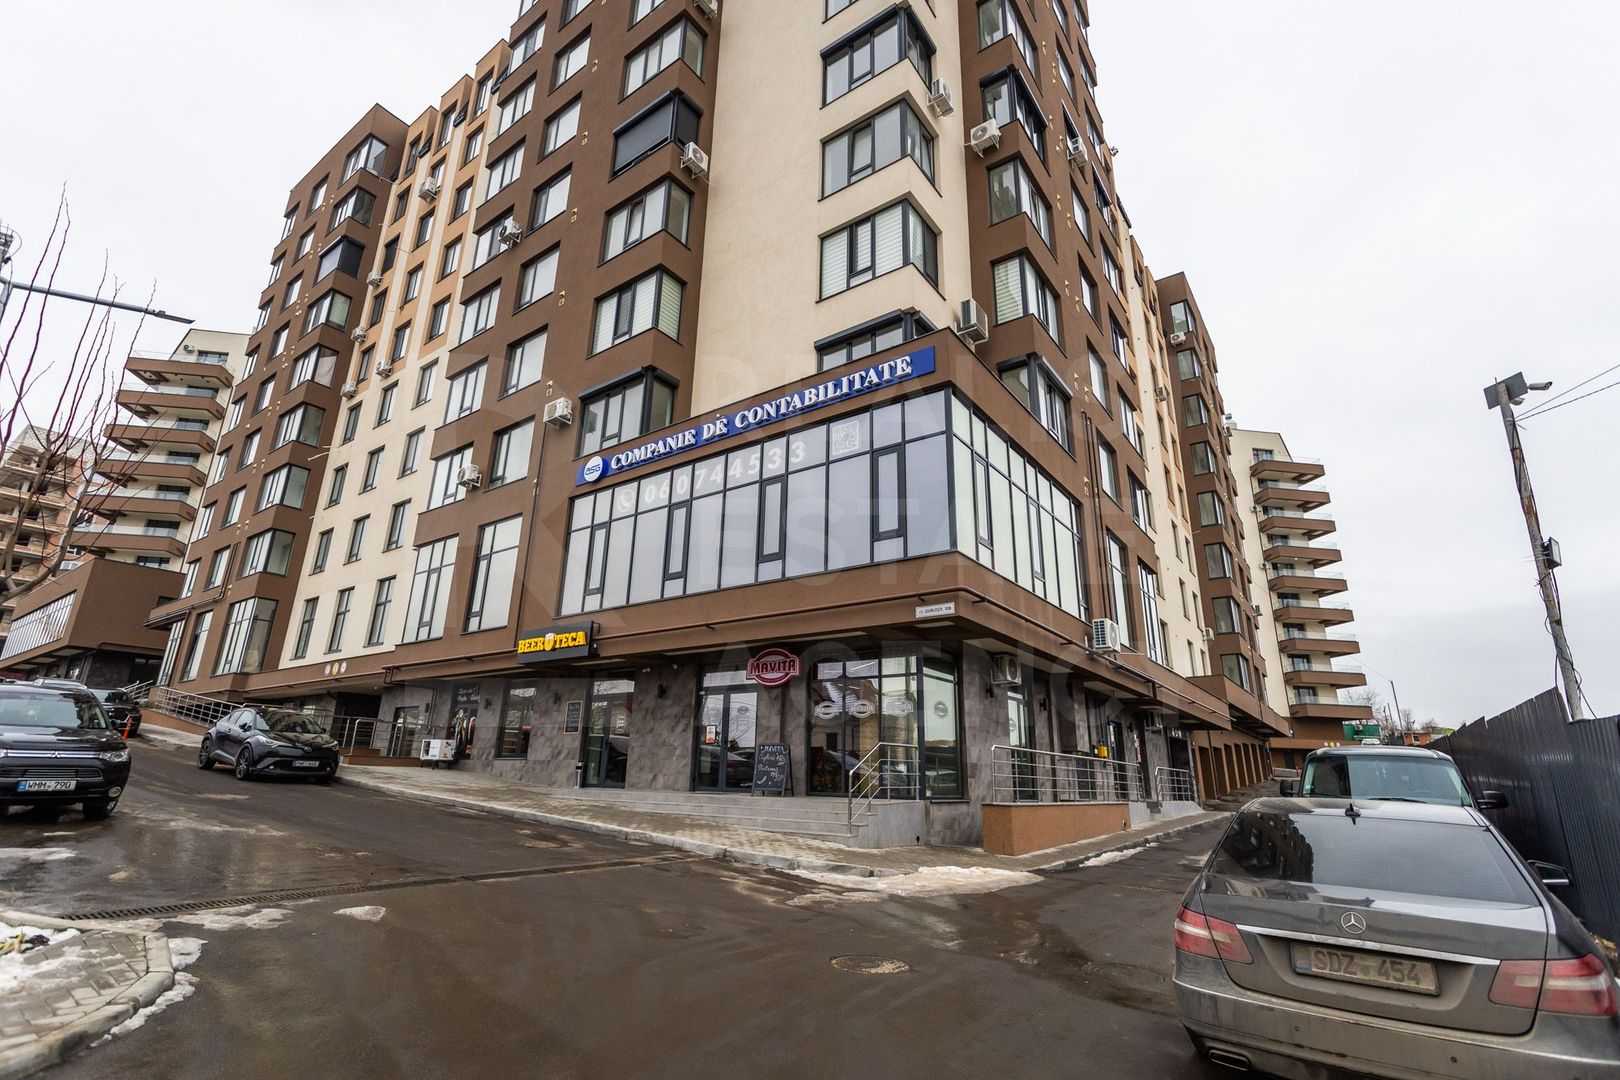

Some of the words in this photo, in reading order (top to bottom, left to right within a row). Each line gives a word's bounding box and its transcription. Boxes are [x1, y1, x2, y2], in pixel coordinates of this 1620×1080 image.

[610, 429, 697, 470] COMPANIE
[702, 416, 728, 442] DE
[734, 354, 914, 429] CONTABILITATE
[643, 440, 808, 506] 060744533
[749, 657, 797, 675] MAVITA
[54, 781, 71, 790] 790
[1313, 949, 1358, 976] SDZ
[1378, 957, 1421, 985] 454
